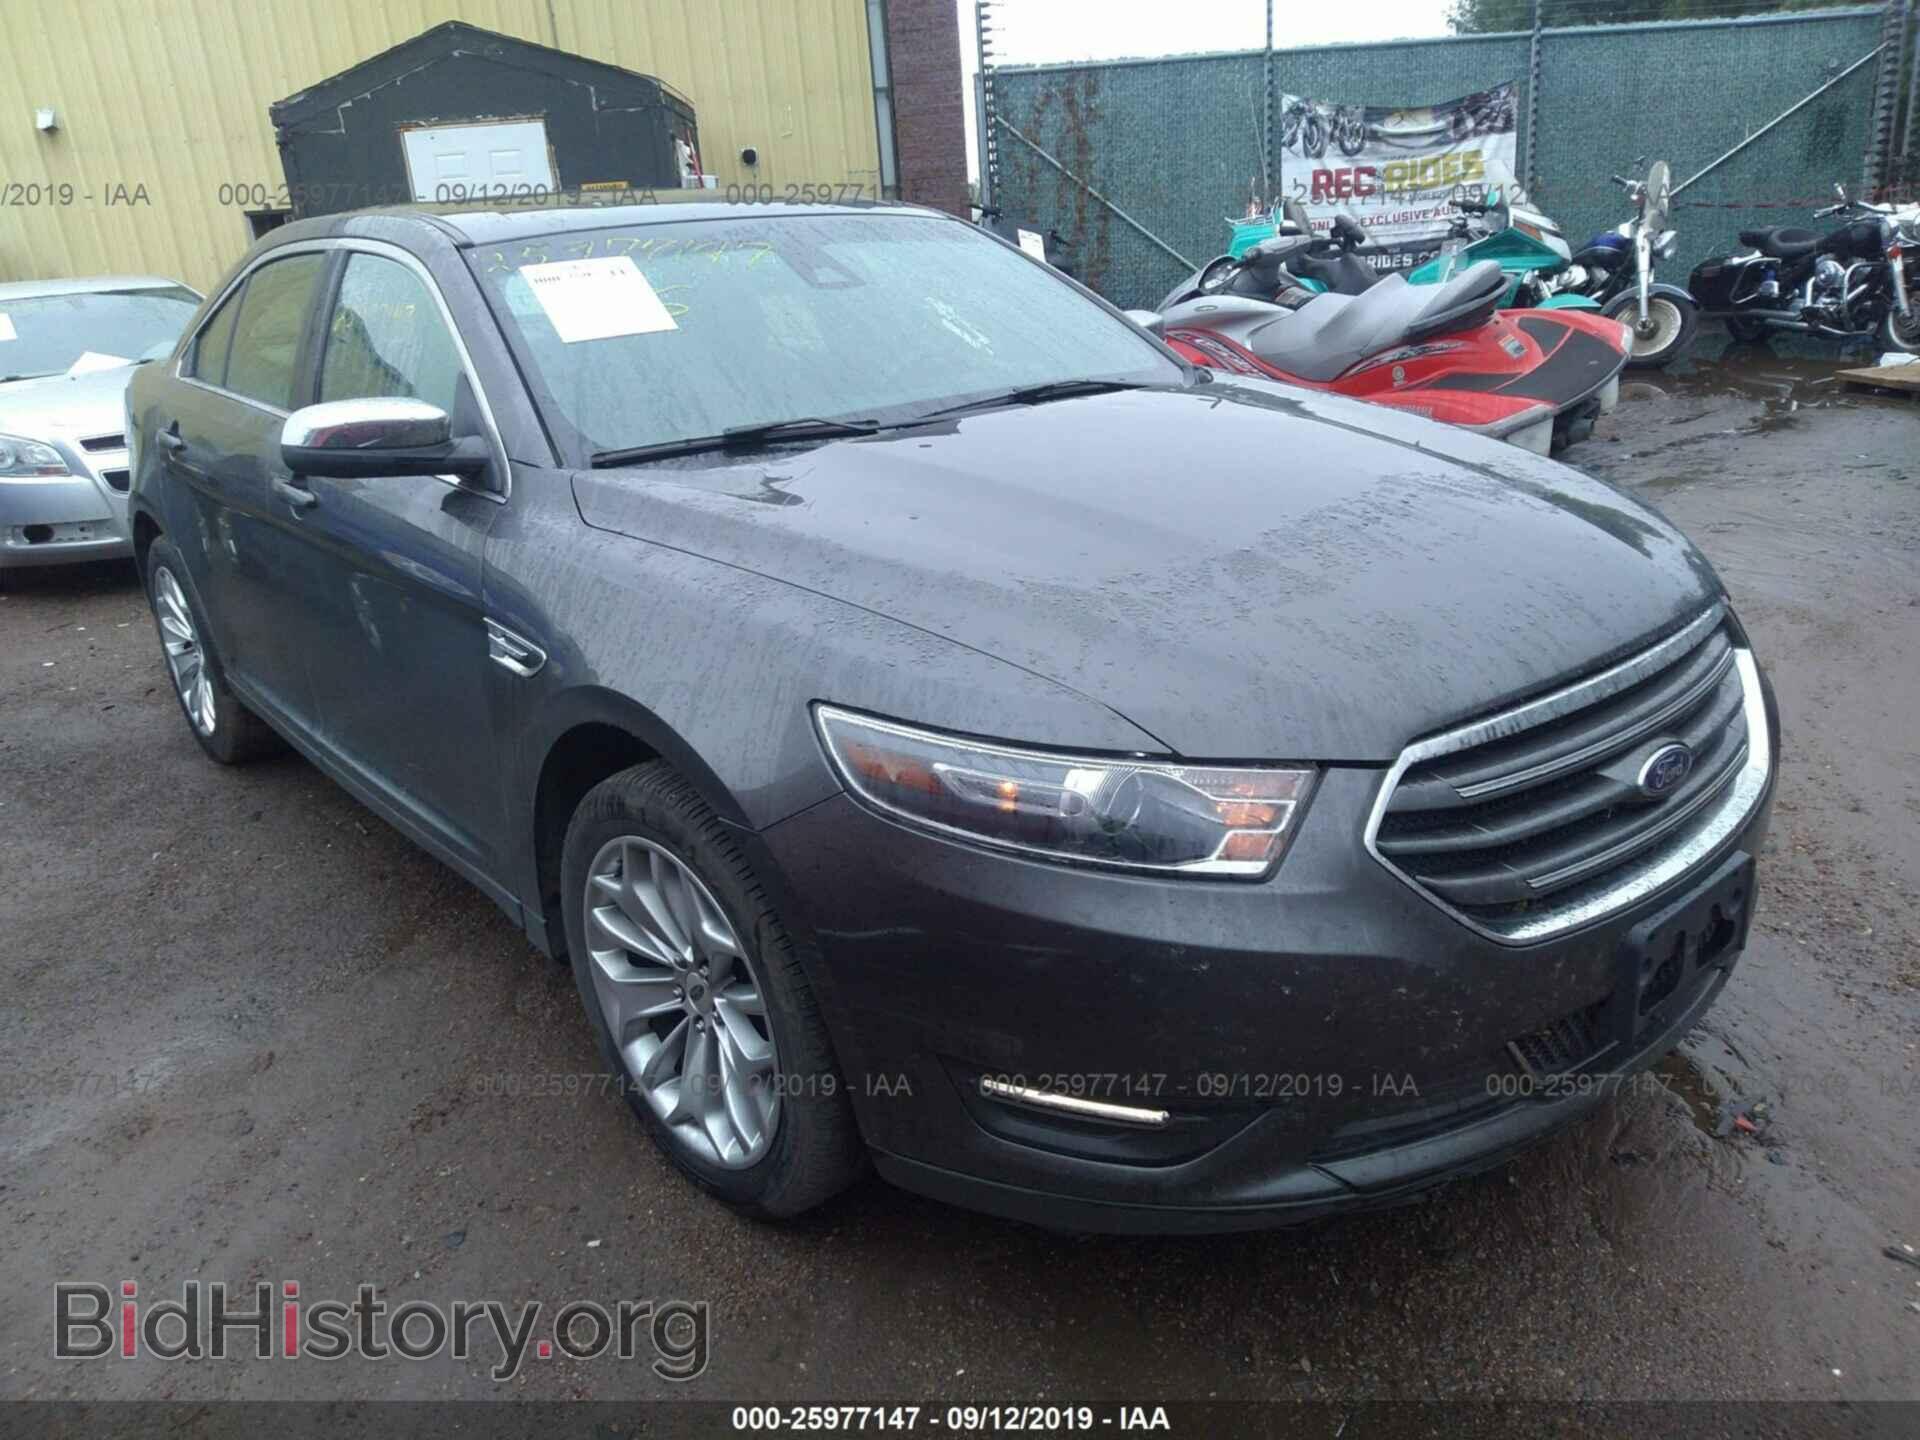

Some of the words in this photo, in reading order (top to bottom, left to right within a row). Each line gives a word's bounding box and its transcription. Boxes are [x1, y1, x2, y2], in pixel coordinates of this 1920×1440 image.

[1311, 165, 1377, 200] REC
[1383, 149, 1485, 192] RIDES
[1359, 208, 1430, 227] EXCLUSIVE
